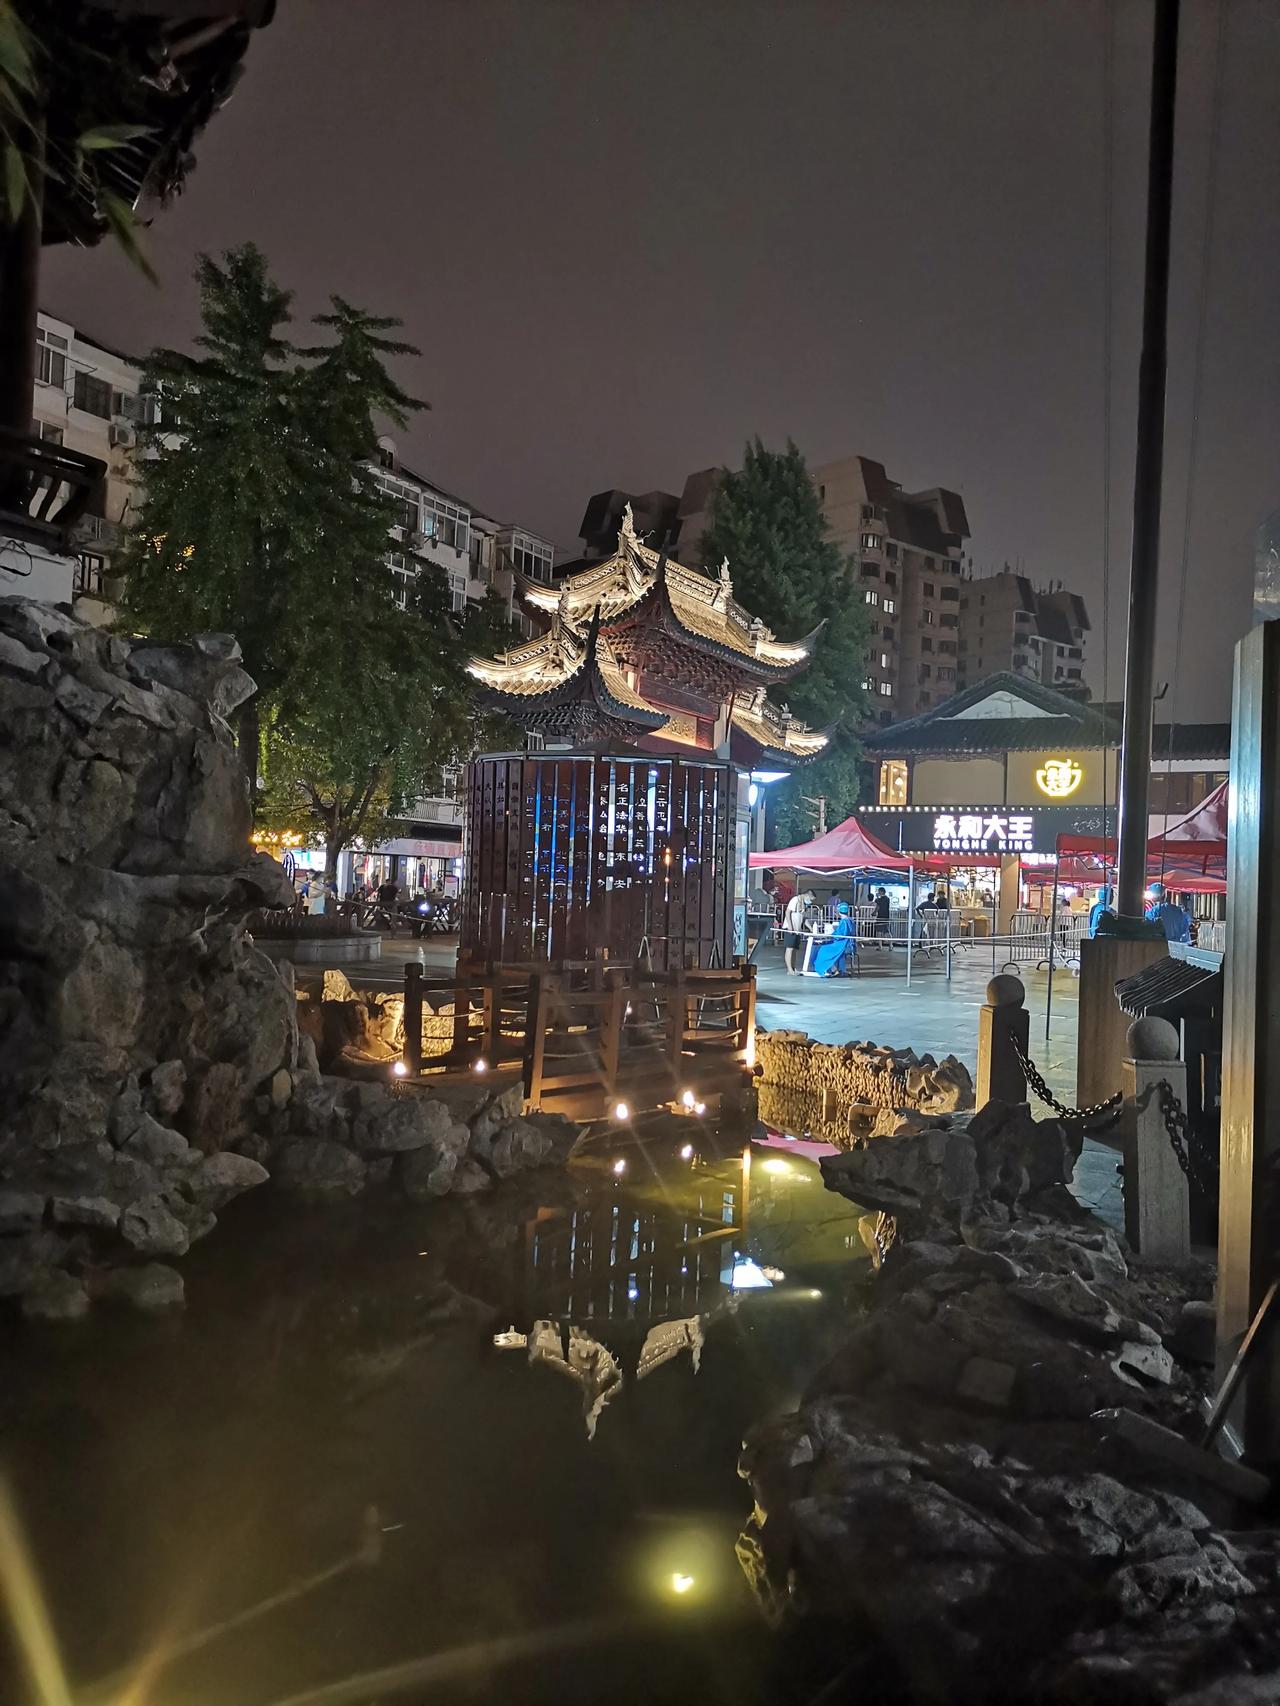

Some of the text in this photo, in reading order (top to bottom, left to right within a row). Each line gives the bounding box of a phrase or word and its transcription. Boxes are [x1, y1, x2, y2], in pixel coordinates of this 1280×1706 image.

[933, 814, 1033, 840] 永和大王
[933, 839, 1033, 851] YONGHE KING
